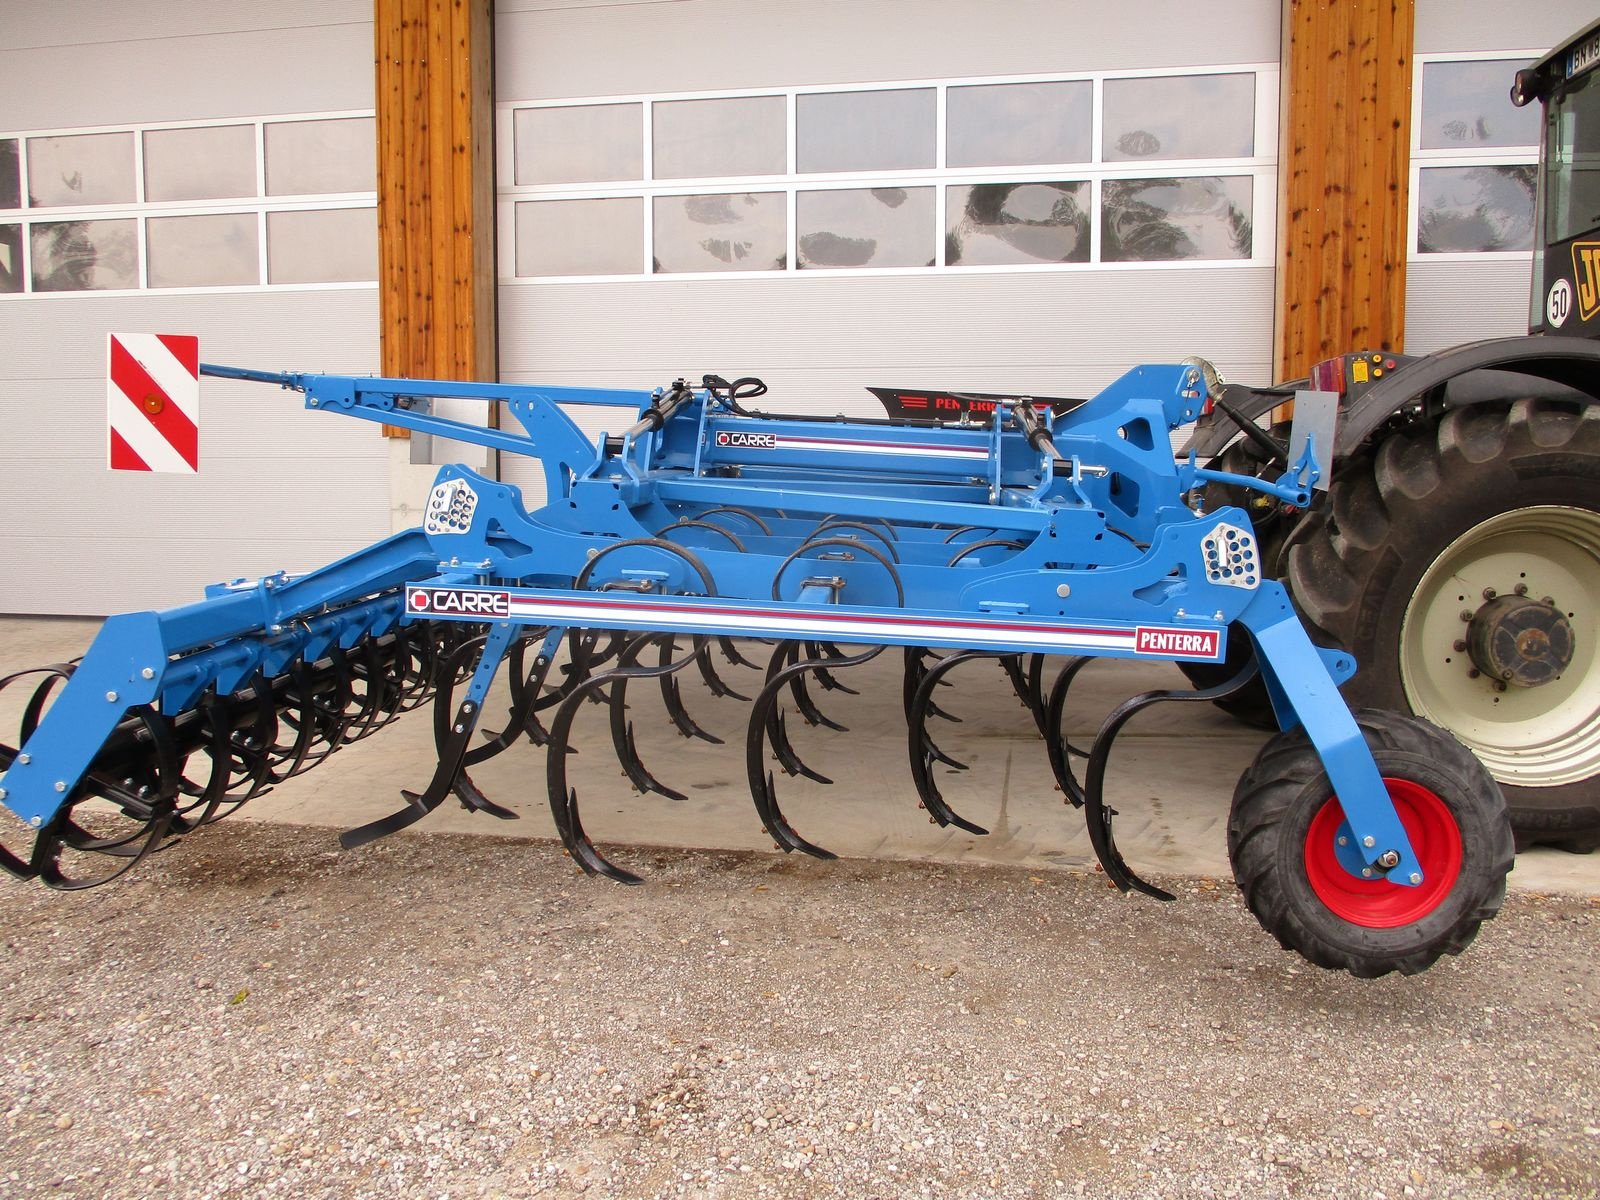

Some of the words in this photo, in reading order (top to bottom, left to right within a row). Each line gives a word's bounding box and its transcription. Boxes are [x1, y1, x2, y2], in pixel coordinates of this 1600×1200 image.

[1574, 46, 1587, 69] BN
[1552, 288, 1567, 320] 50
[731, 433, 774, 447] CARRE
[433, 591, 508, 613] CARRE
[1140, 632, 1212, 652] PENTERRA
